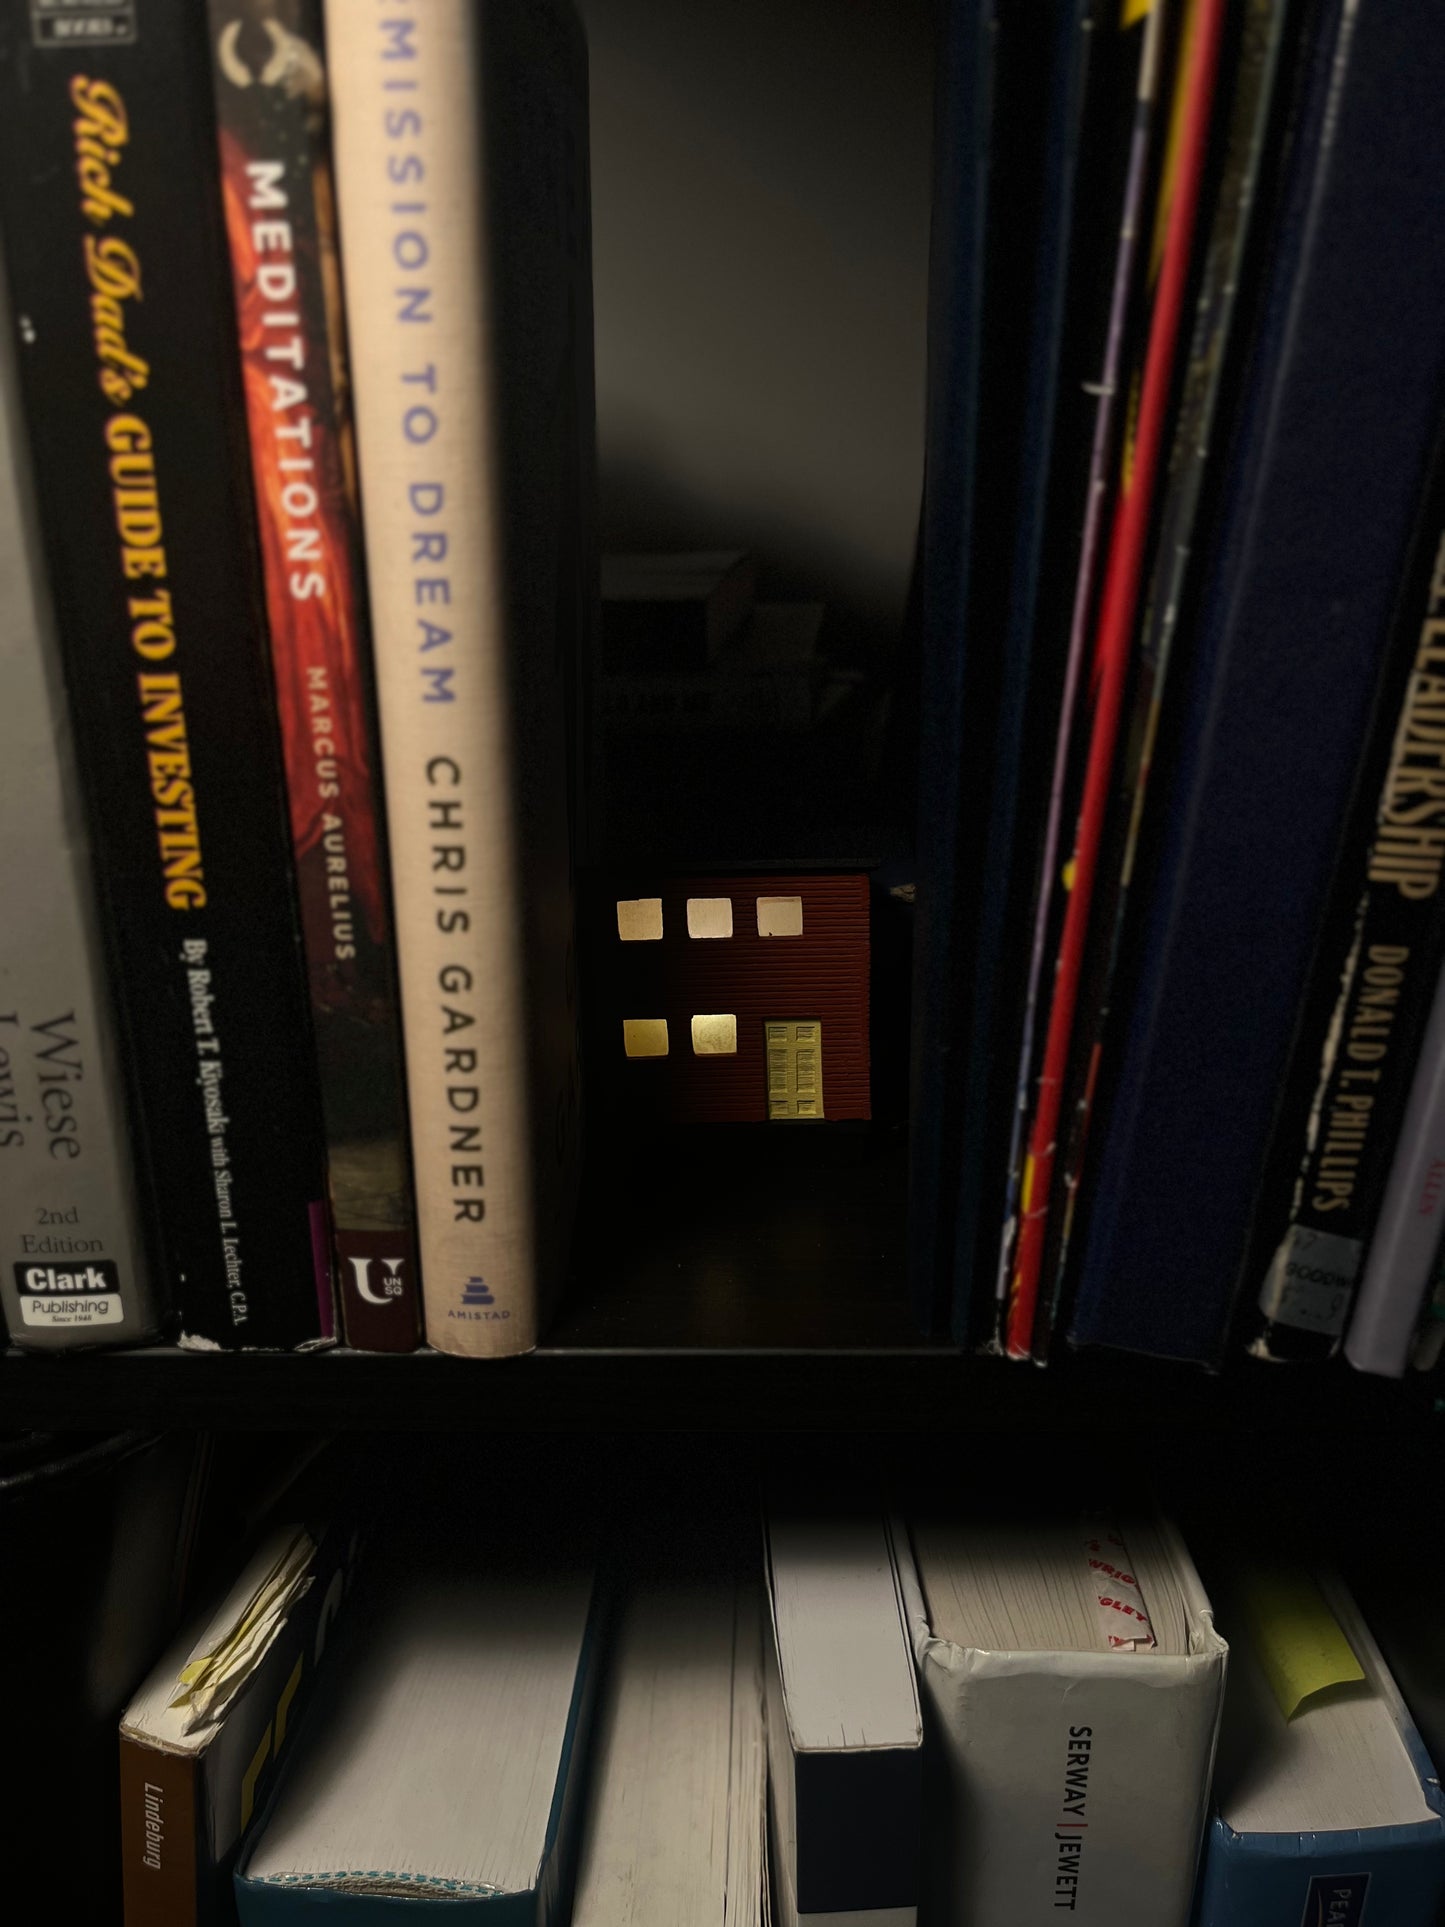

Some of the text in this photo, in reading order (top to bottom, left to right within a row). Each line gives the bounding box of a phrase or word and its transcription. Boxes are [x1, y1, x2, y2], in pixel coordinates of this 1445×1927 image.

[69, 73, 135, 228] Rich
[84, 233, 150, 407] Dad's
[245, 159, 325, 601] MEDITATIONS
[105, 412, 167, 579] GUIDE
[128, 589, 177, 661] TO
[379, 0, 485, 1222] MISSION TO DREAM CHRIS GARDNER
[138, 671, 207, 912] INVESTING
[306, 666, 356, 960] MARCUS AURELIUS
[178, 937, 208, 967] By
[186, 968, 216, 1035] Robert
[196, 1036, 221, 1056] T.
[1311, 944, 1411, 1214] DONALD T. PHILLIPS
[30, 1007, 83, 1160] Wiese
[195, 1060, 231, 1135] Kiyosaki
[210, 1136, 230, 1168] with
[36, 1206, 79, 1225] 2nd
[213, 1169, 234, 1219] Sharon
[21, 1233, 104, 1254] Edition
[25, 1266, 107, 1291] Clark
[32, 1300, 109, 1314] Publishing
[448, 1310, 511, 1320] AMISTAD
[1088, 1558, 1138, 1586] WRIG
[1098, 1596, 1148, 1622] GLEY
[143, 1782, 163, 1870] Lindeburg
[1054, 1725, 1092, 1910] SERWAY JEWETT
[1326, 1888, 1352, 1927] PEA
